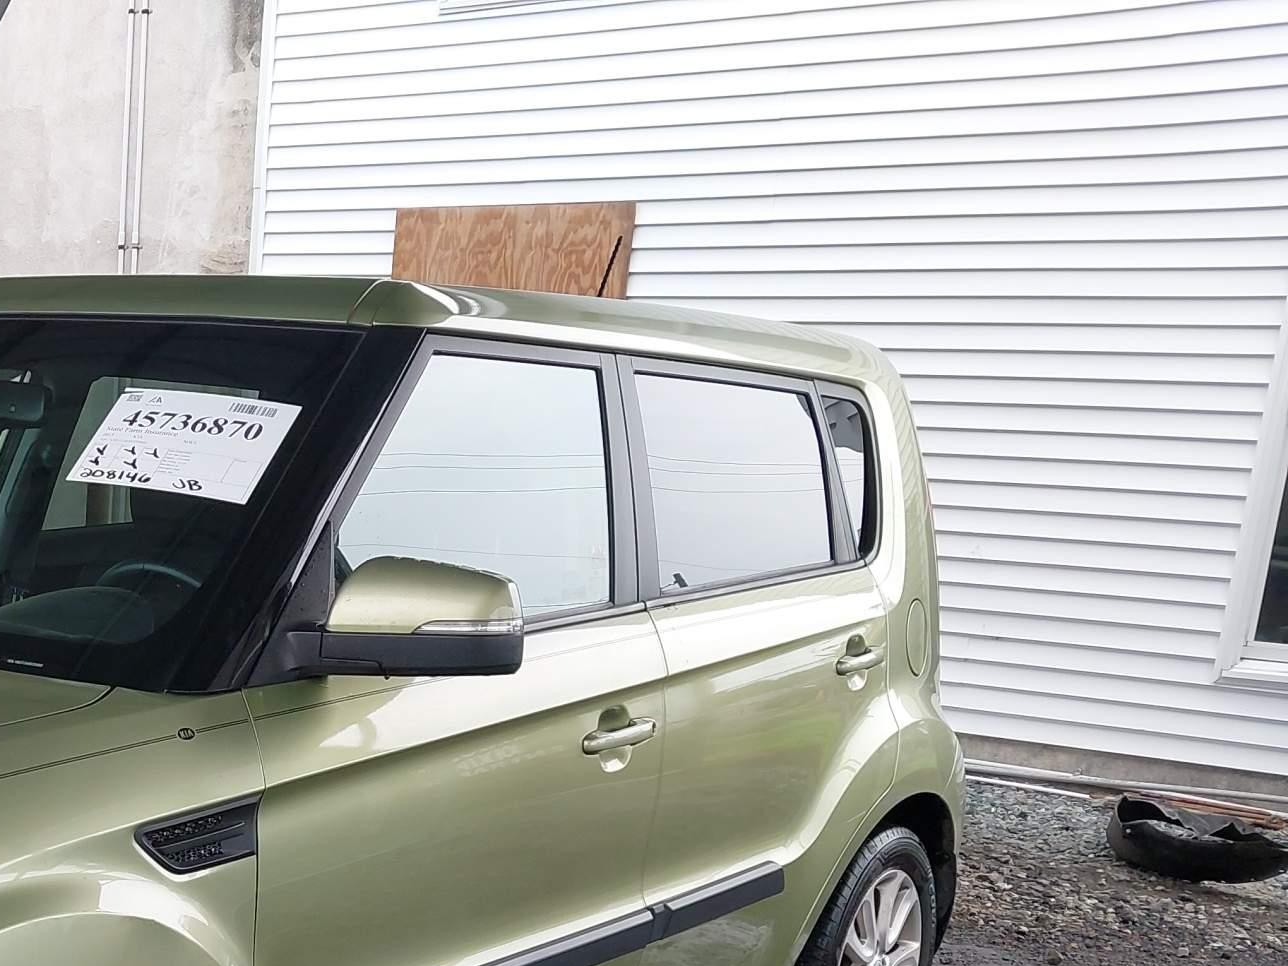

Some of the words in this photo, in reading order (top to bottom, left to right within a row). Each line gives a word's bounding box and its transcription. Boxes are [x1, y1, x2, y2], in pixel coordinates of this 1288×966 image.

[122, 410, 263, 440] 45736870
[80, 468, 151, 483] 208146
[172, 479, 203, 491] JB
